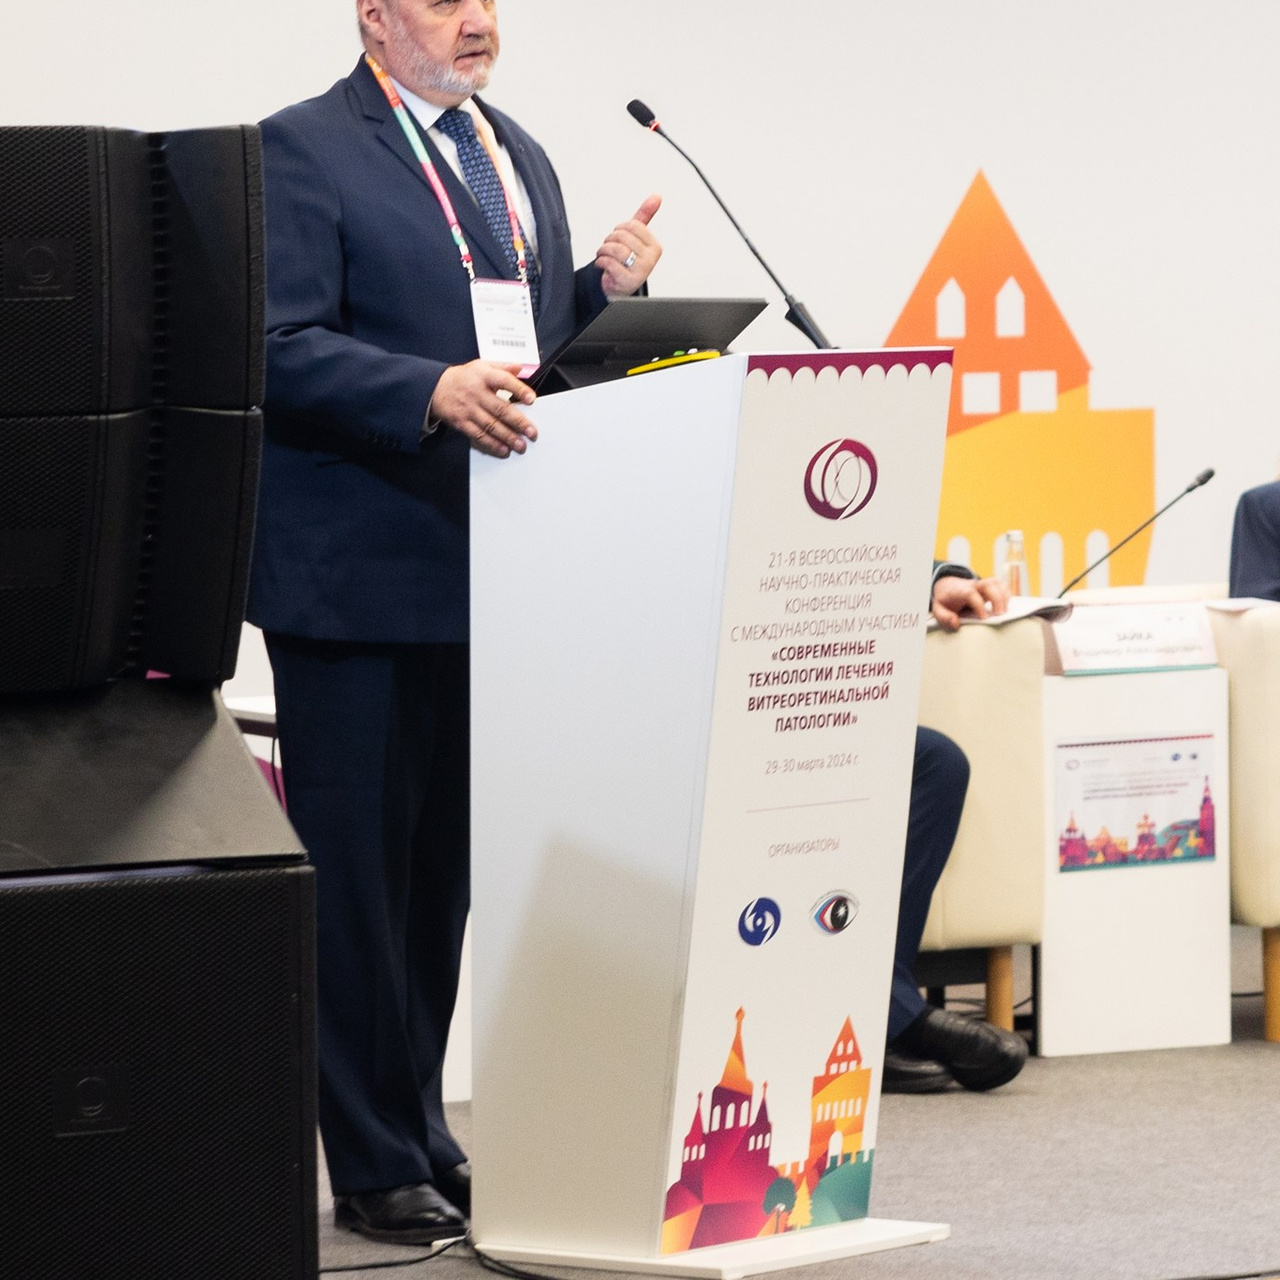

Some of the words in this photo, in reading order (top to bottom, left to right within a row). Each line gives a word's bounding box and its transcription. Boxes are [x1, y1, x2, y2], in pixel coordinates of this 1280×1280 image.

[767, 550, 797, 569] 21-Я
[798, 543, 898, 567] ВСЕРОССИЙСКАЯ
[758, 566, 902, 593] НАУЧНО-ПРАКТИЧЕСКАЯ
[784, 591, 873, 615] КОНФЕРЕНЦИЯ
[730, 625, 741, 643] С
[740, 616, 856, 643] МЕЖДУНАРОДНЫМ
[857, 612, 920, 633] УЧАСТИЕМ
[771, 639, 876, 662] «СОВРЕМЕННЫЕ
[748, 665, 834, 688] ТЕХНОЛОГИИ
[835, 661, 894, 681] ЛЕЧЕНИЯ
[747, 680, 890, 712] ВИТРЕОРЕТИНАЛЬНОЙ
[774, 711, 858, 733] ПАТОЛОГИИ»
[764, 757, 796, 775] 29-30
[796, 758, 825, 773] марта
[826, 752, 852, 769] 2024
